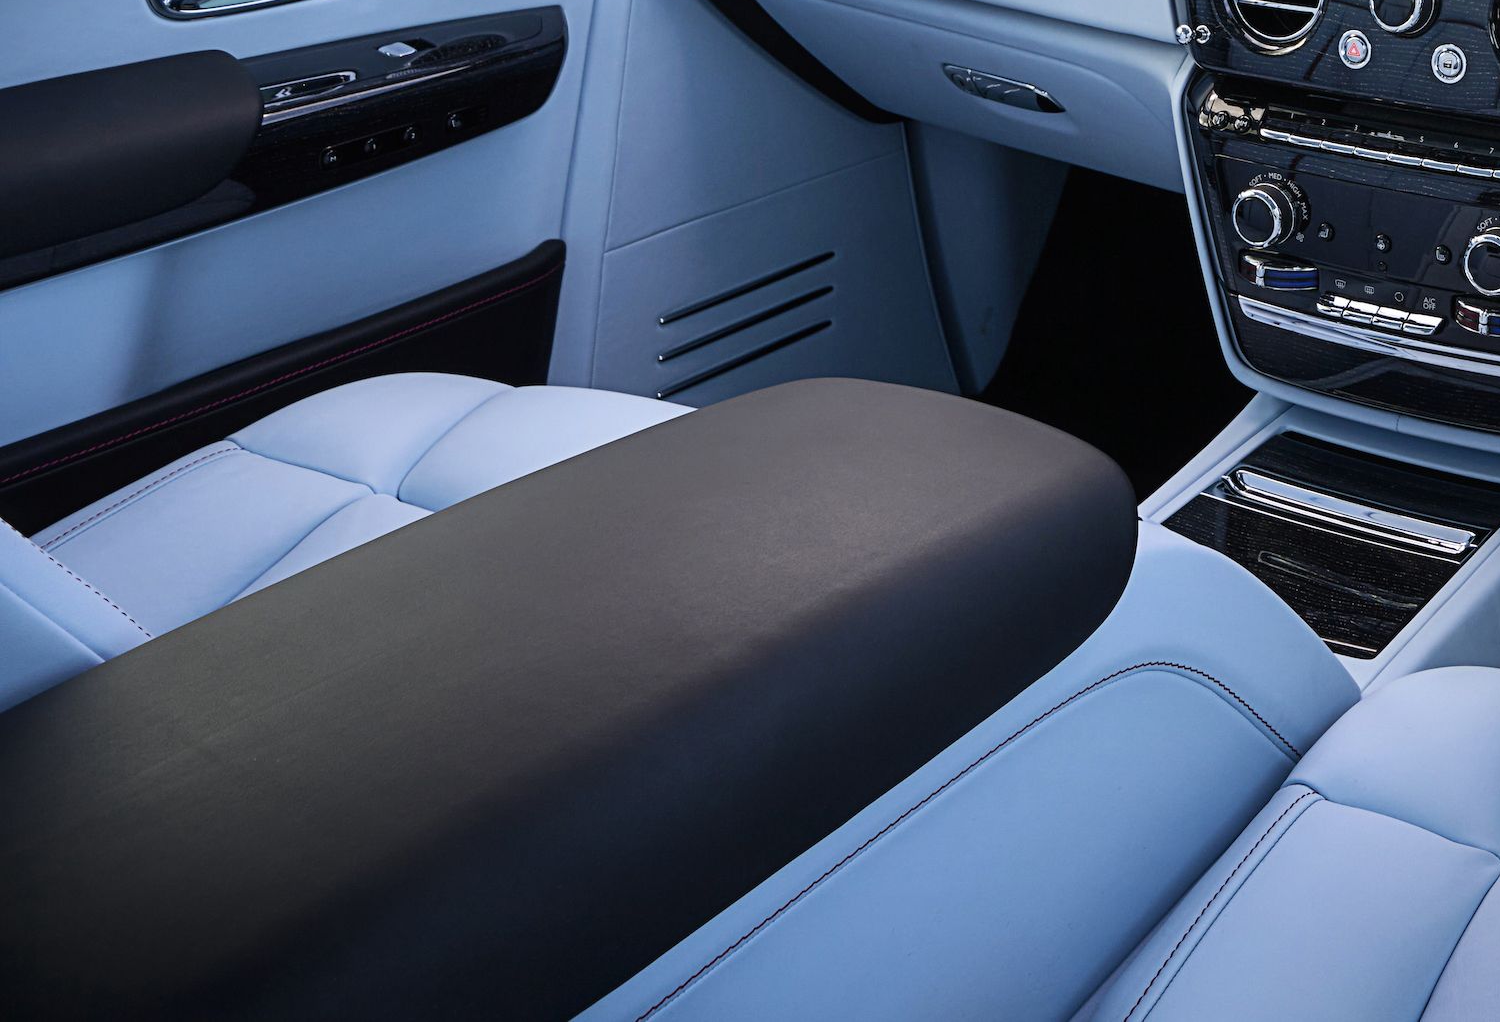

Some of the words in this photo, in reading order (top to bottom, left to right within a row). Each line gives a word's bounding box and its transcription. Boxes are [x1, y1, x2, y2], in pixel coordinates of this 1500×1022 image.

[1453, 141, 1459, 149] 6
[1249, 173, 1263, 187] SOFT
[1268, 172, 1282, 181] MED
[1287, 180, 1302, 198] HIGH
[1300, 202, 1308, 221] MAX
[1476, 217, 1493, 232] SOFT
[1423, 296, 1436, 305] A/C
